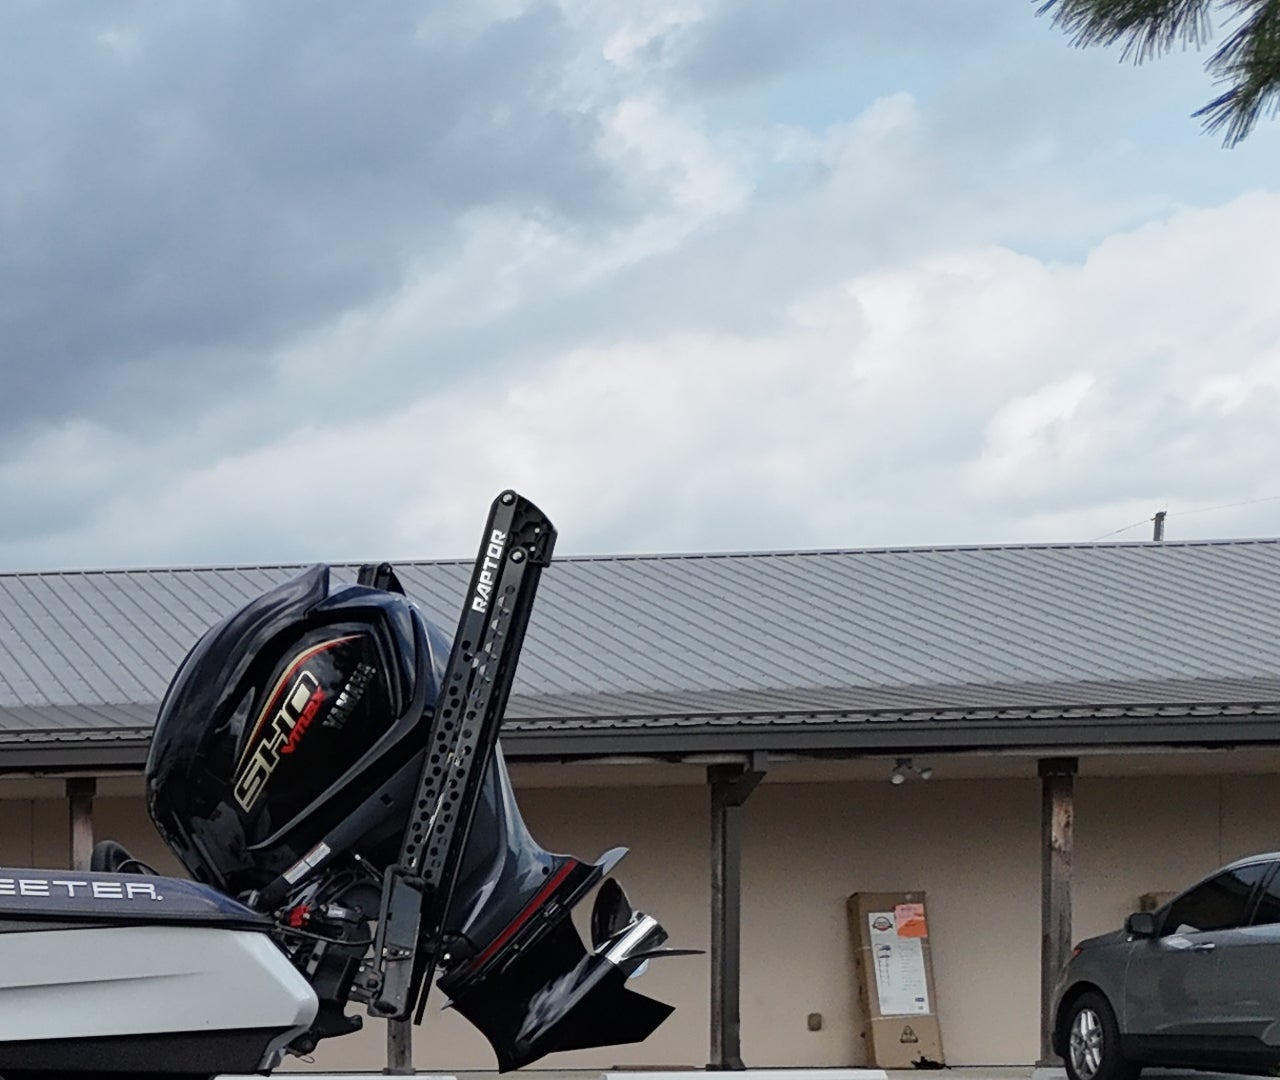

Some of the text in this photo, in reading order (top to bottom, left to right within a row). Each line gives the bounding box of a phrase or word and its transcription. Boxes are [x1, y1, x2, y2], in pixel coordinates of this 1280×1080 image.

[471, 529, 506, 613] RAPTOR
[322, 662, 377, 730] YAMAHA
[234, 670, 320, 813] SHO
